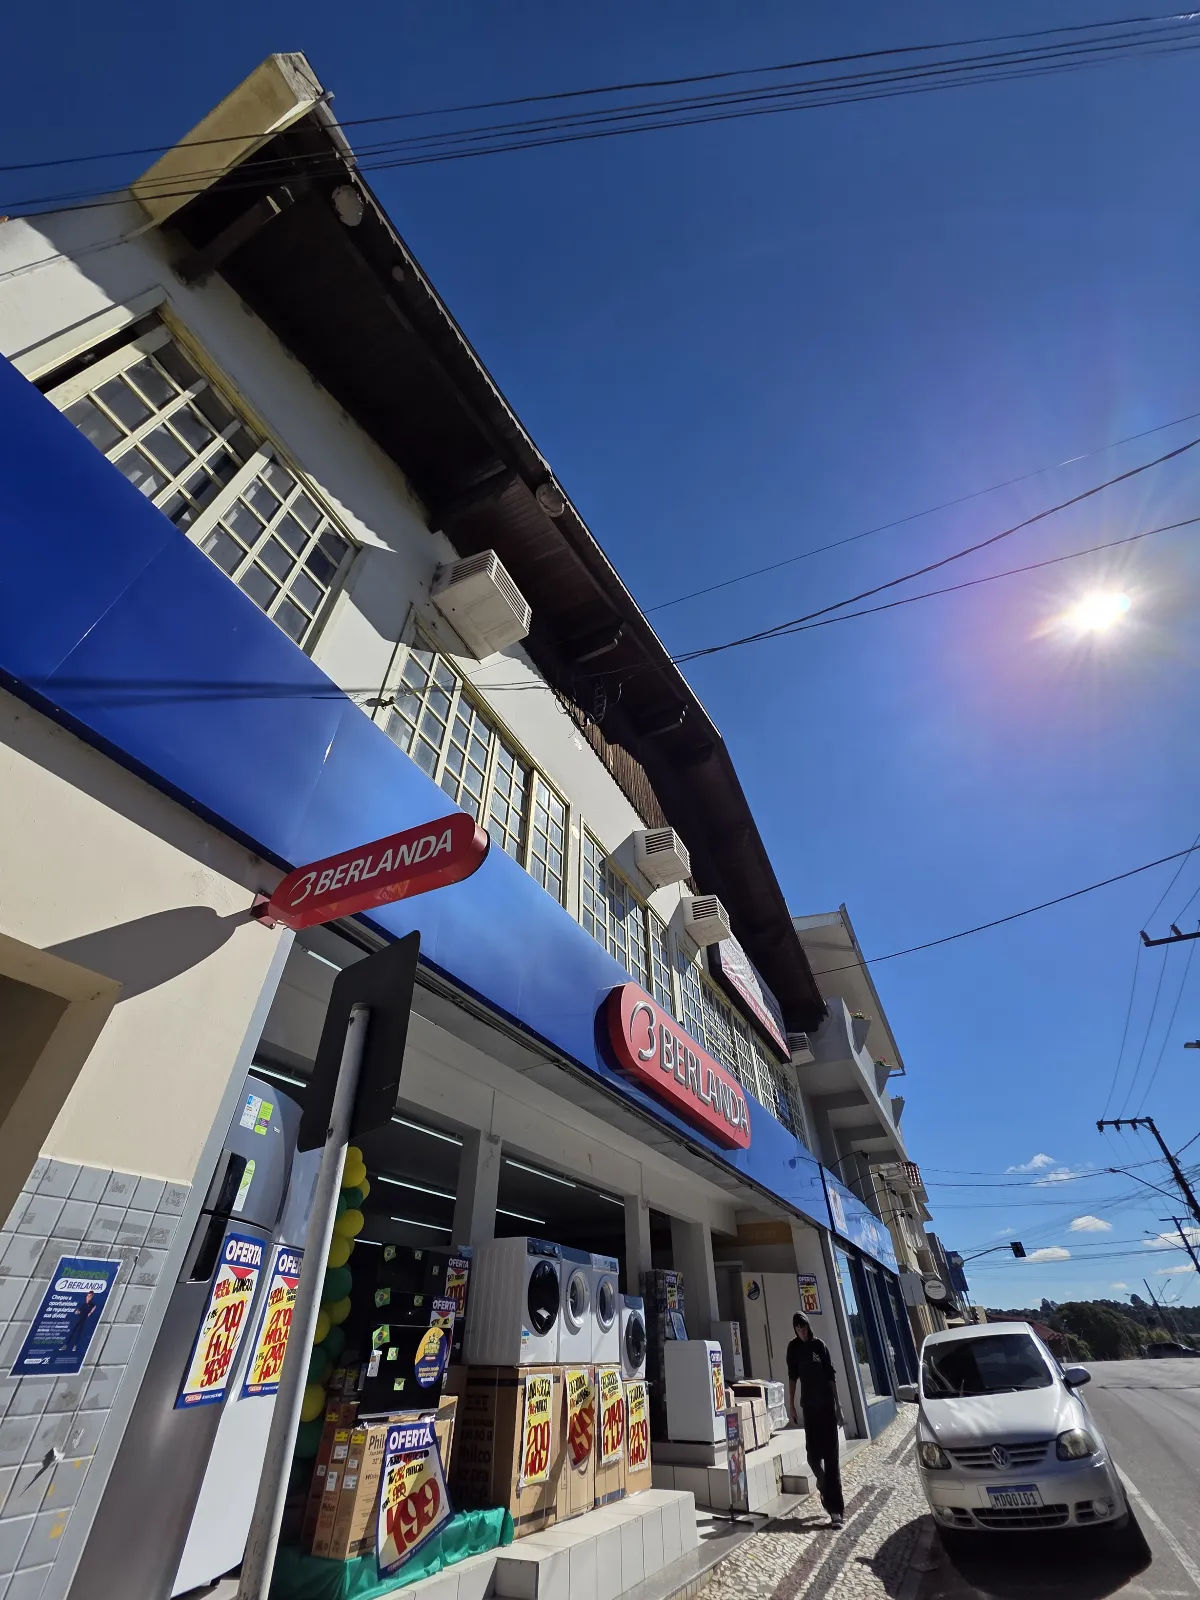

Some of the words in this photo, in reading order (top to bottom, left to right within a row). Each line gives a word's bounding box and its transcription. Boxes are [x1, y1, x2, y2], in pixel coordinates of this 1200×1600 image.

[313, 829, 452, 896] BERLANDA
[660, 1023, 750, 1137] BERLANDA
[225, 1240, 262, 1266] OFERTA
[278, 1254, 301, 1274] OFER
[448, 1258, 469, 1269] OFERTA
[67, 1281, 104, 1291] BERLANDA
[432, 1299, 456, 1311] OFERTA
[368, 1434, 386, 1450] Phil
[389, 1427, 434, 1450] OFERTA
